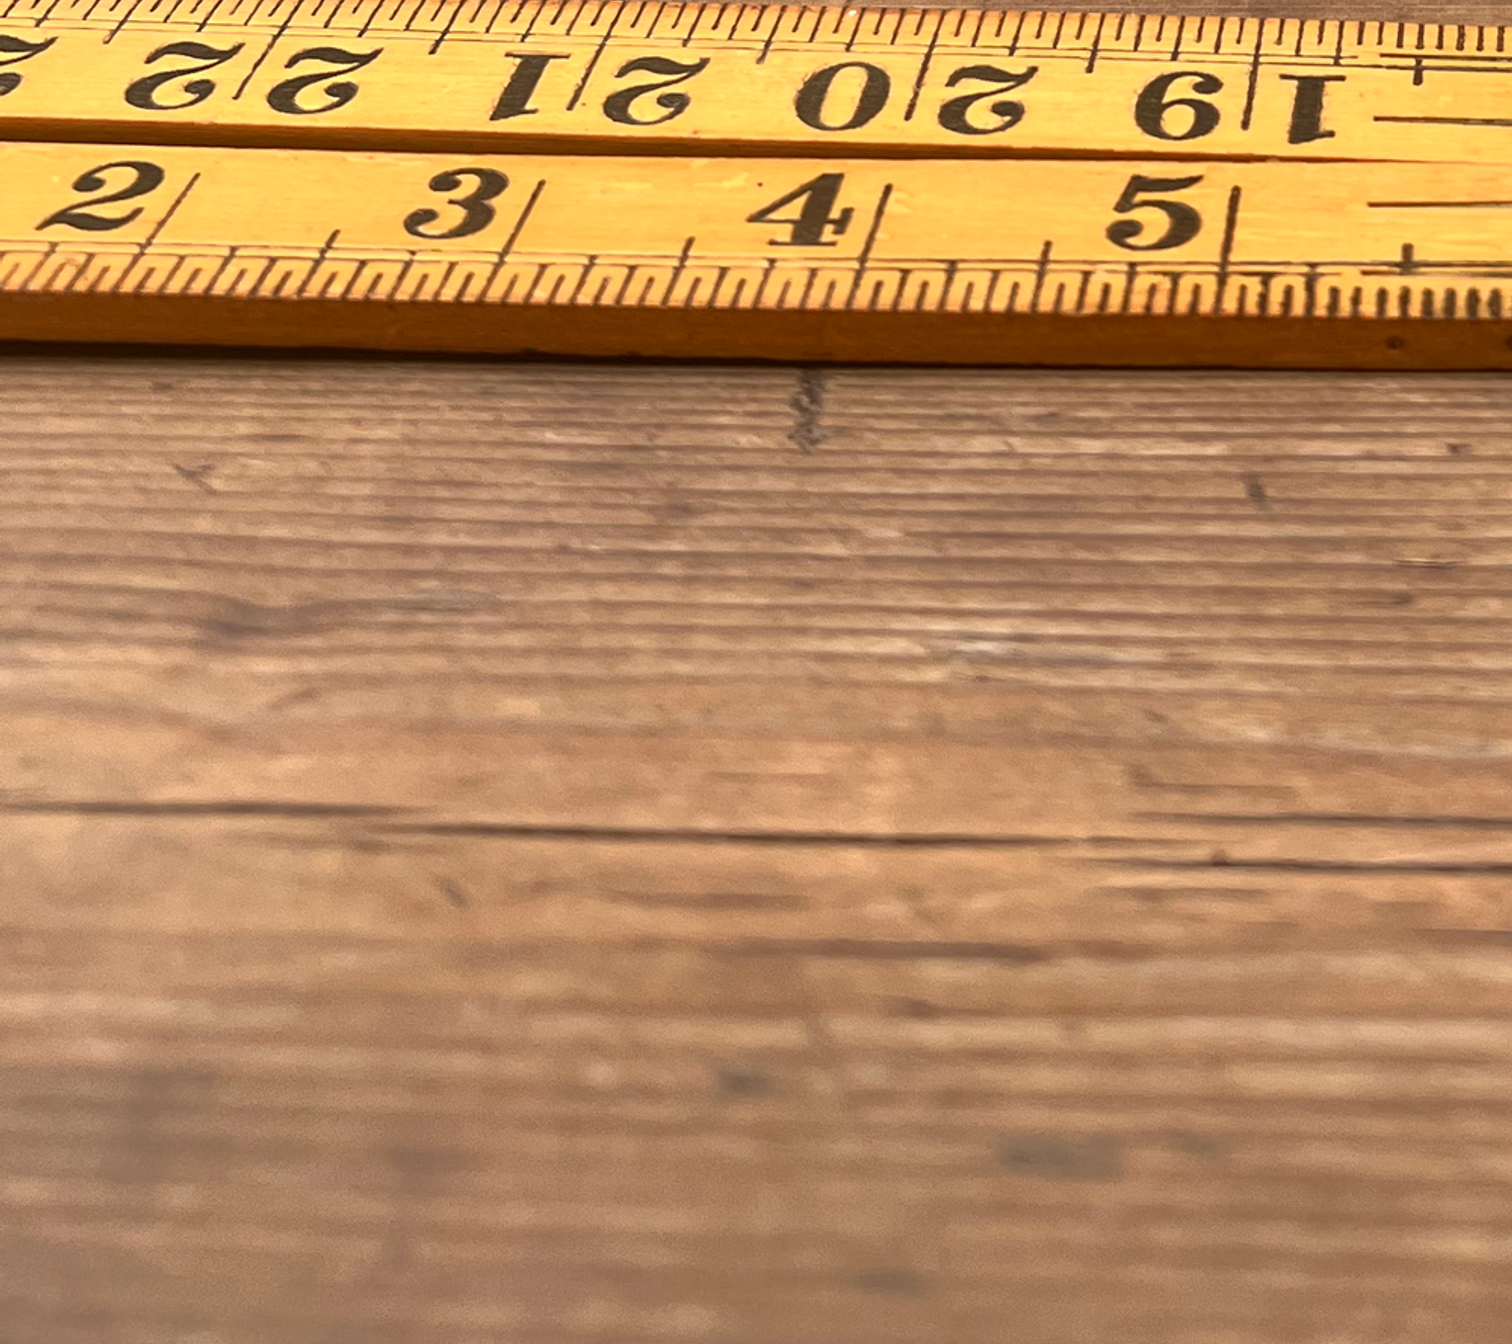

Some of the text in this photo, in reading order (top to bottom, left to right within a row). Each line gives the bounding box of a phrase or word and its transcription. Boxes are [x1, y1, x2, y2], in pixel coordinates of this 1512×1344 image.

[35, 160, 165, 231] 2
[403, 168, 509, 239] 3
[747, 173, 853, 246] 4
[1106, 175, 1204, 251] 5
